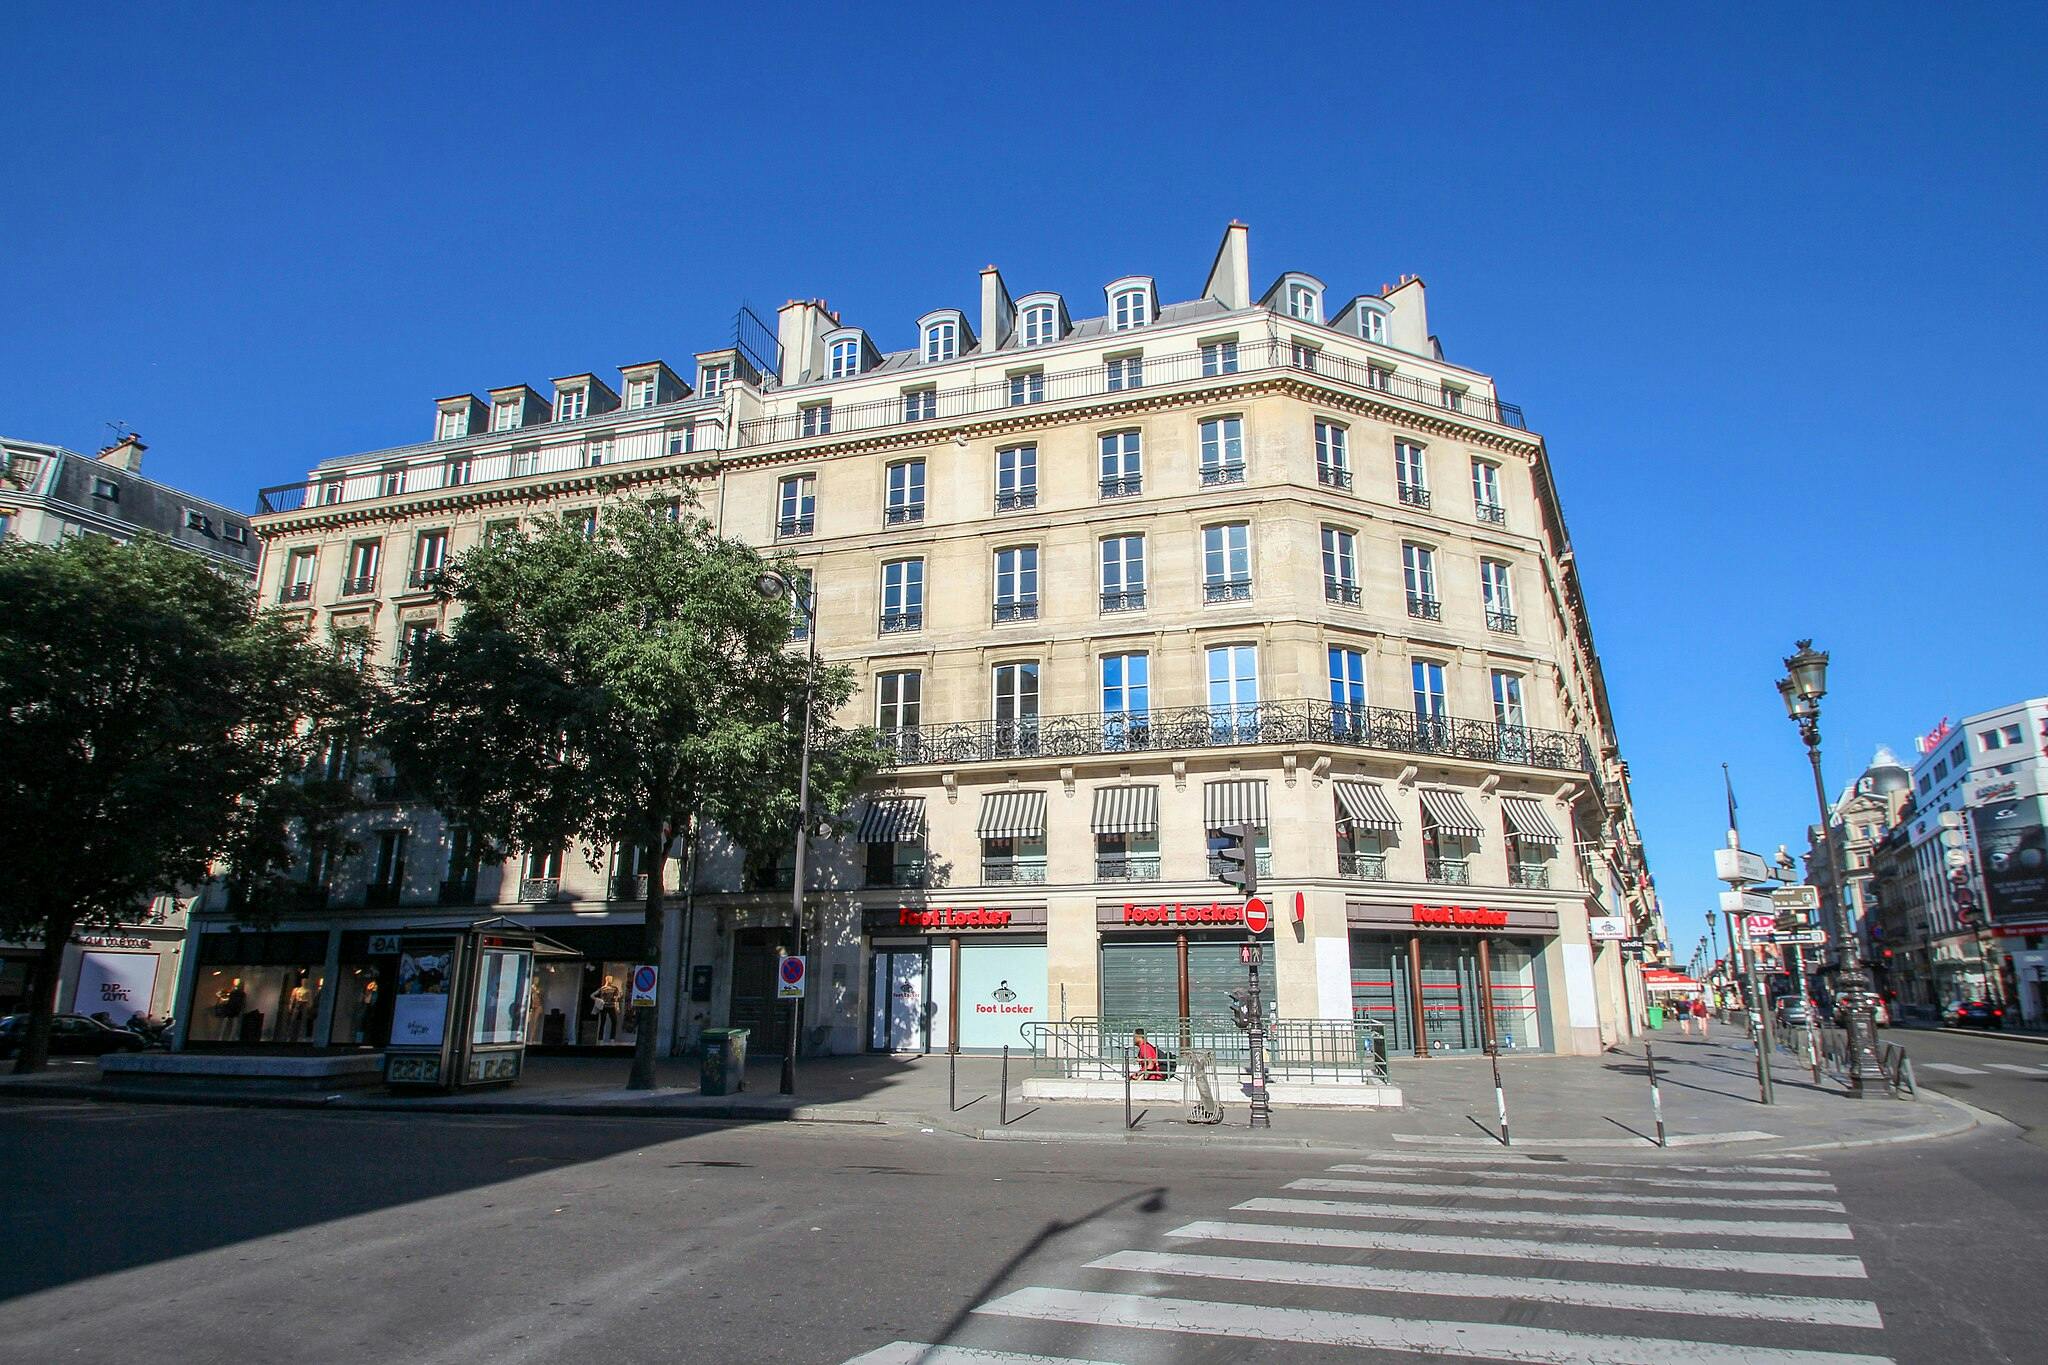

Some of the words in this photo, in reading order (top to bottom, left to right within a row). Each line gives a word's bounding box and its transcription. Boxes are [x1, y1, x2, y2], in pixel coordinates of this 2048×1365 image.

[899, 908, 941, 926] Foot
[944, 906, 1011, 926] Locker
[1123, 902, 1172, 925] Foot
[1175, 902, 1245, 926] Locker
[1411, 904, 1451, 923] Foot
[1452, 905, 1509, 926] Locker
[102, 992, 129, 1002] am
[976, 1004, 998, 1014] Foot
[1000, 1004, 1034, 1014] Locker
